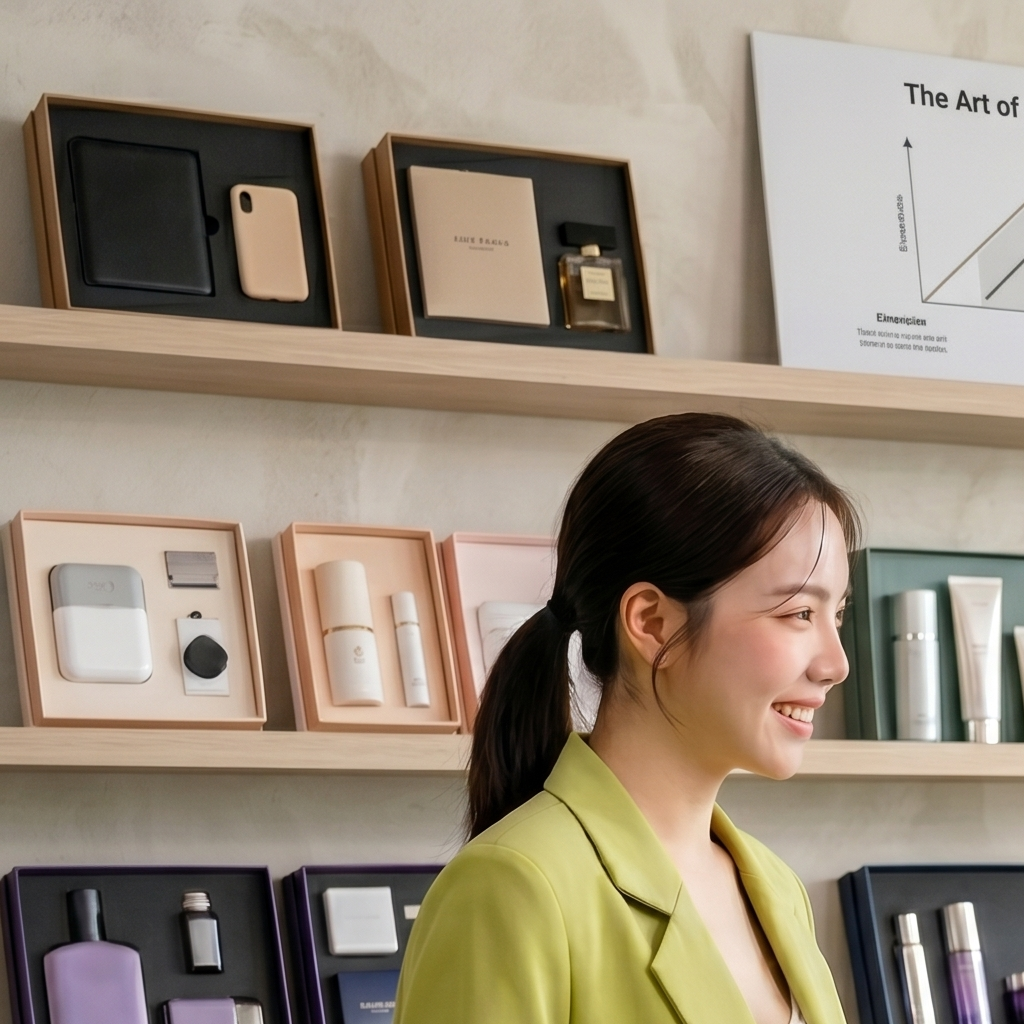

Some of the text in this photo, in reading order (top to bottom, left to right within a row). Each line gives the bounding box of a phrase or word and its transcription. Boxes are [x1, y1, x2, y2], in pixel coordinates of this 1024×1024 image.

[903, 82, 949, 109] The
[955, 89, 991, 115] Art
[996, 96, 1020, 118] of
